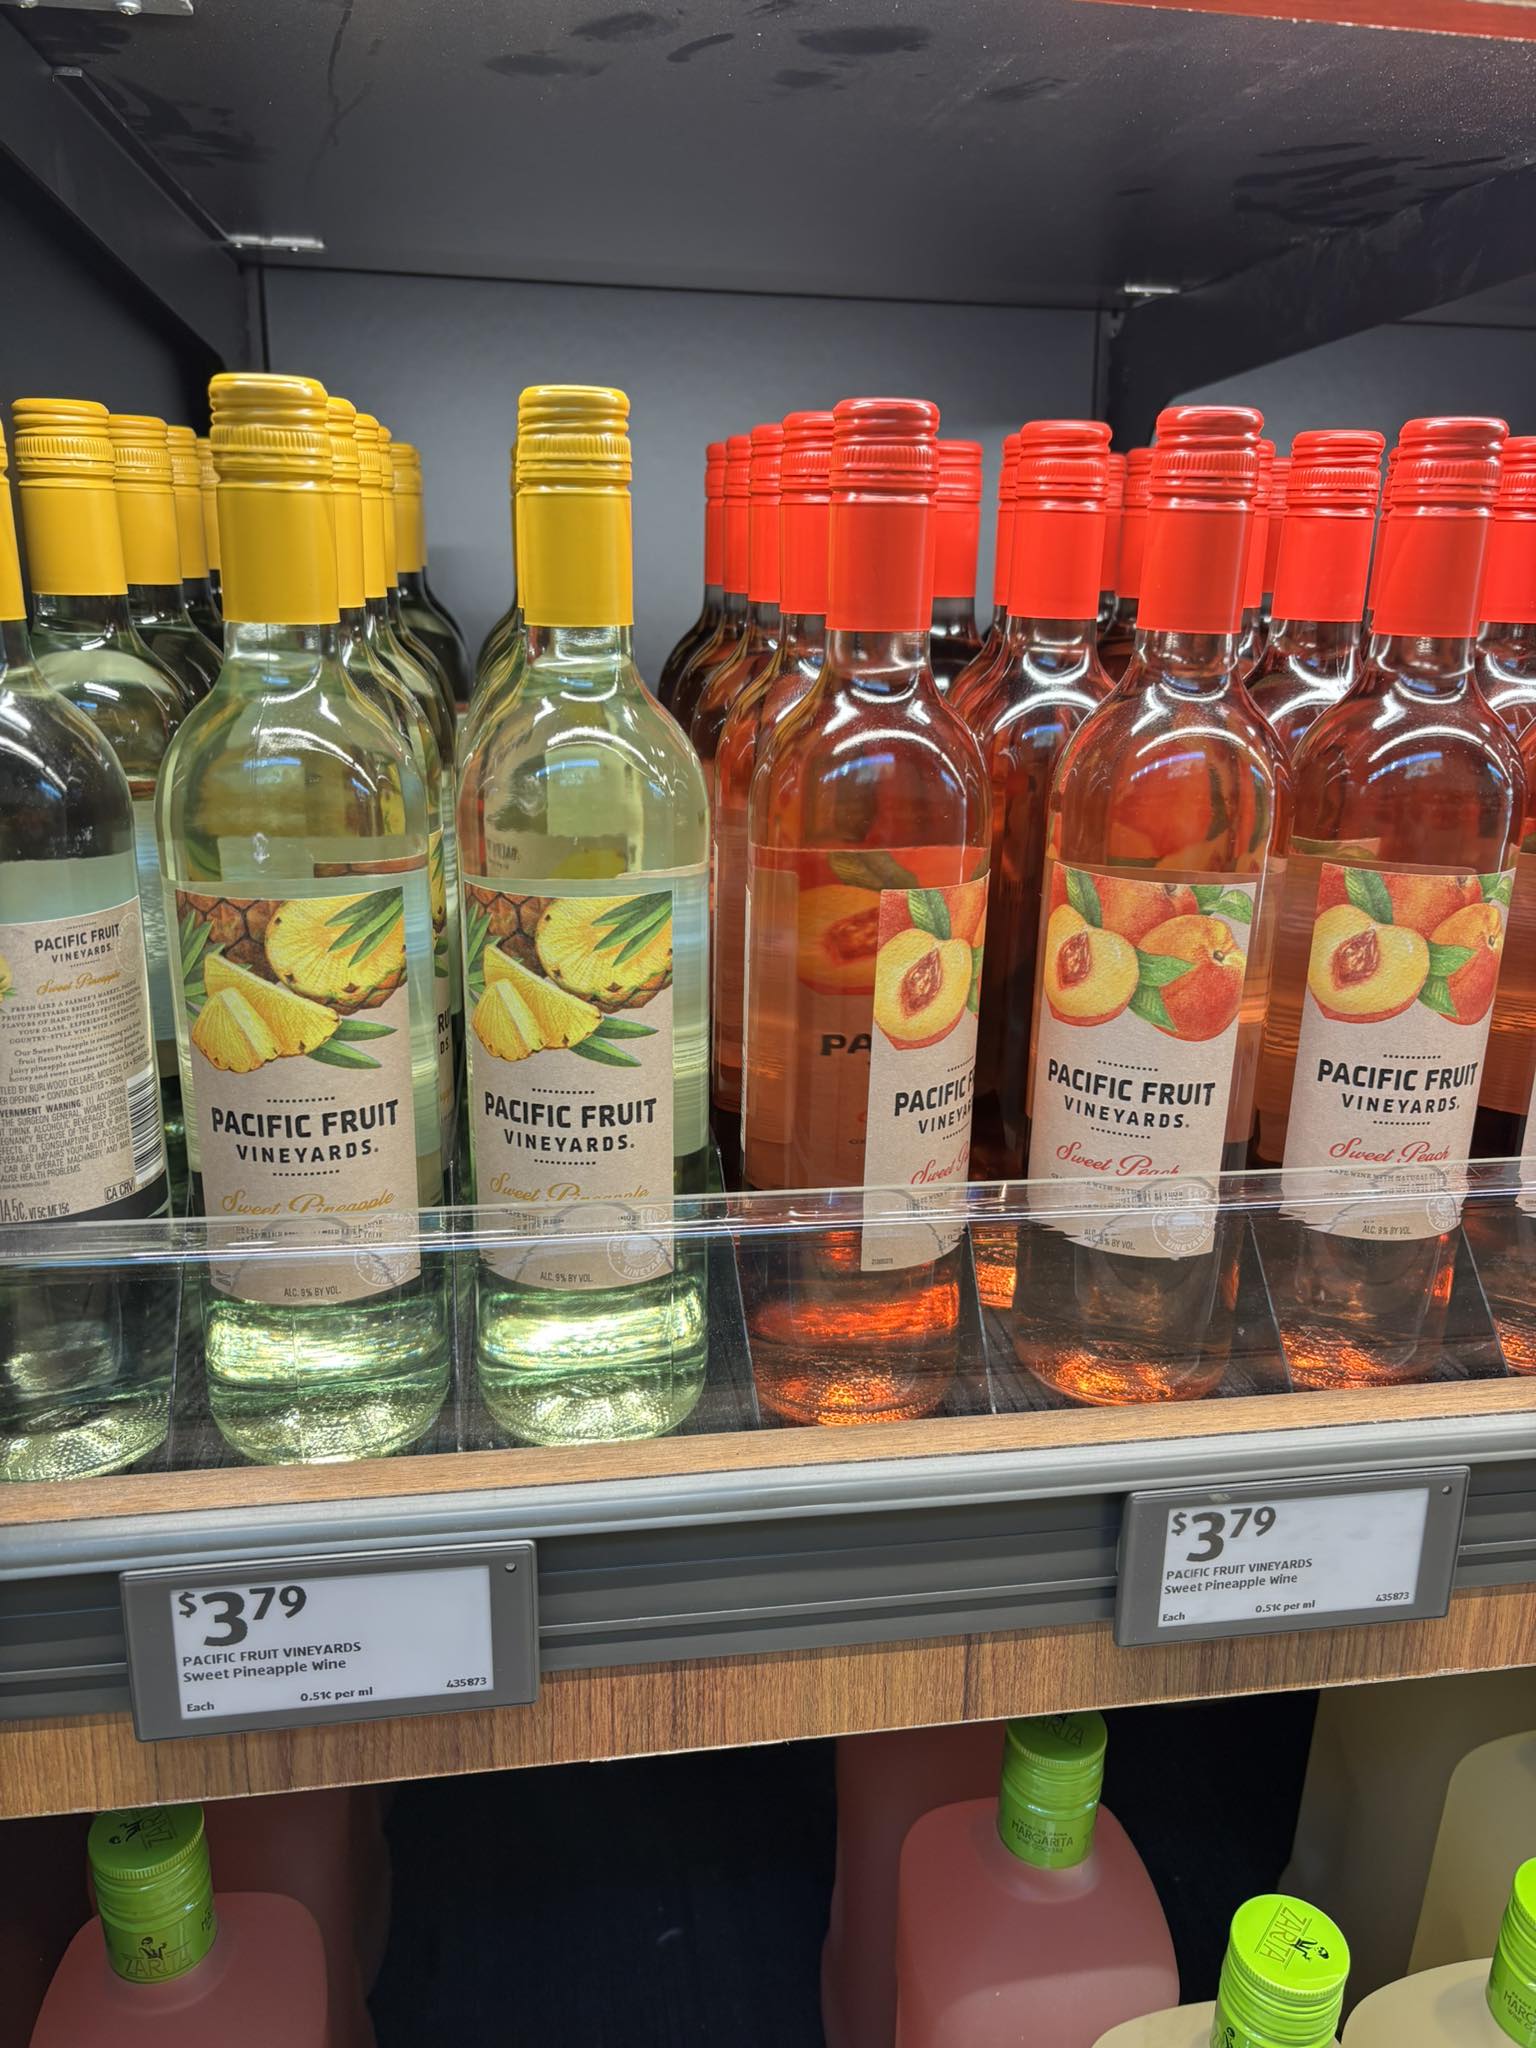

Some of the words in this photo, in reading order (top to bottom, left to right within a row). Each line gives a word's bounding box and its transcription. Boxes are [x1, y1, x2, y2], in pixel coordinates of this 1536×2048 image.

[34, 932, 88, 954] PACIFIC
[90, 923, 120, 943] FRUIT
[37, 978, 72, 996] Sweet
[75, 970, 121, 990] Pineapple
[2, 1021, 36, 1029] FLAVORS
[50, 1008, 100, 1024] HAND-PICKED
[11, 1005, 36, 1013] FRESH
[38, 1002, 56, 1010] LIKE
[28, 1008, 70, 1019] VINEYARDS
[10, 1031, 72, 1044] COUNTRY-STYLE
[74, 1026, 91, 1035] WINE
[18, 1028, 40, 1036] YOUR
[70, 1014, 108, 1028] EXPERIENCE
[38, 1055, 62, 1063] flavors
[63, 1050, 77, 1058] that
[56, 1040, 88, 1052] Pineapple
[30, 1062, 66, 1074] pineapple
[68, 1054, 95, 1064] cascades
[1317, 1058, 1418, 1091] PACIFIC
[1424, 1061, 1478, 1091] FRUIT
[9, 1073, 32, 1082] honey
[34, 1072, 48, 1080] and
[50, 1070, 68, 1078] sweet
[18, 1085, 28, 1094] BY
[30, 1079, 68, 1092] BURLWOOD
[1048, 1058, 1133, 1102] PACIFIC
[1141, 1082, 1216, 1106] FRUIT
[10, 1094, 40, 1105] OPENING
[47, 1087, 79, 1100] CONTAINS
[80, 1080, 104, 1094] SULFITES
[894, 1075, 967, 1116] PACIFIC
[2, 1119, 16, 1127] THE
[18, 1115, 50, 1126] SURGEON
[83, 1102, 106, 1115] WOMEN
[211, 1106, 312, 1139] PACIFIC
[322, 1099, 399, 1136] FRUIT
[484, 1091, 572, 1128] PACIFIC
[580, 1098, 657, 1128] FRUIT
[9, 1126, 31, 1136] DRINK
[34, 1120, 70, 1133] ALCOHOLIC
[74, 1111, 106, 1127] BEVERAGES
[36, 1131, 65, 1142] BECAUSE
[68, 1128, 76, 1137] OF
[78, 1124, 90, 1134] THE
[92, 1122, 104, 1131] RISK
[28, 1144, 38, 1153] (2)
[41, 1135, 90, 1151] CONSUMPTION
[92, 1131, 100, 1140] OF
[36, 1150, 64, 1161] IMPAIRS
[66, 1146, 84, 1155] YOUR
[86, 1138, 106, 1151] ABILITY
[1328, 1137, 1396, 1163] Sweet
[1396, 1140, 1450, 1164] Peach
[4, 1164, 18, 1174] CAR
[22, 1163, 32, 1172] OR
[34, 1158, 64, 1170] OPERATE
[106, 1144, 118, 1154] AND
[1056, 1141, 1114, 1171] Sweet
[20, 1171, 46, 1181] HEALTH
[910, 1158, 957, 1184] Sweet
[106, 1187, 118, 1200] CA
[119, 1180, 134, 1196] CRV
[490, 1172, 542, 1202] Sweet
[222, 1189, 282, 1215] Sweet
[568, 1273, 578, 1282] BY
[314, 1286, 324, 1296] BY
[1166, 1567, 1210, 1581] PACIFIC
[1213, 1563, 1245, 1576] FRUIT
[1248, 1558, 1313, 1573] VINEYARDS
[1164, 1582, 1203, 1595] Sweet
[1204, 1576, 1266, 1594] Pineapple
[1269, 1572, 1298, 1585] Wine
[1376, 1592, 1410, 1602] 435873
[1162, 1612, 1186, 1622] Each
[1254, 1602, 1282, 1614] 0.51¢
[1283, 1602, 1302, 1614] per
[1302, 1600, 1316, 1610] ml
[182, 1652, 237, 1667] PACIFIC
[240, 1648, 280, 1662] FRUIT
[283, 1641, 362, 1658] VINEYARDS
[183, 1668, 230, 1682] Sweet
[233, 1662, 308, 1682] Pineapple
[311, 1657, 347, 1672] Wine
[446, 1676, 488, 1688] 435873
[186, 1701, 216, 1712] Each
[300, 1688, 333, 1702] 0.51¢
[334, 1689, 356, 1702] per
[358, 1686, 374, 1698] ml
[1012, 1820, 1074, 1848] MARGARITA
